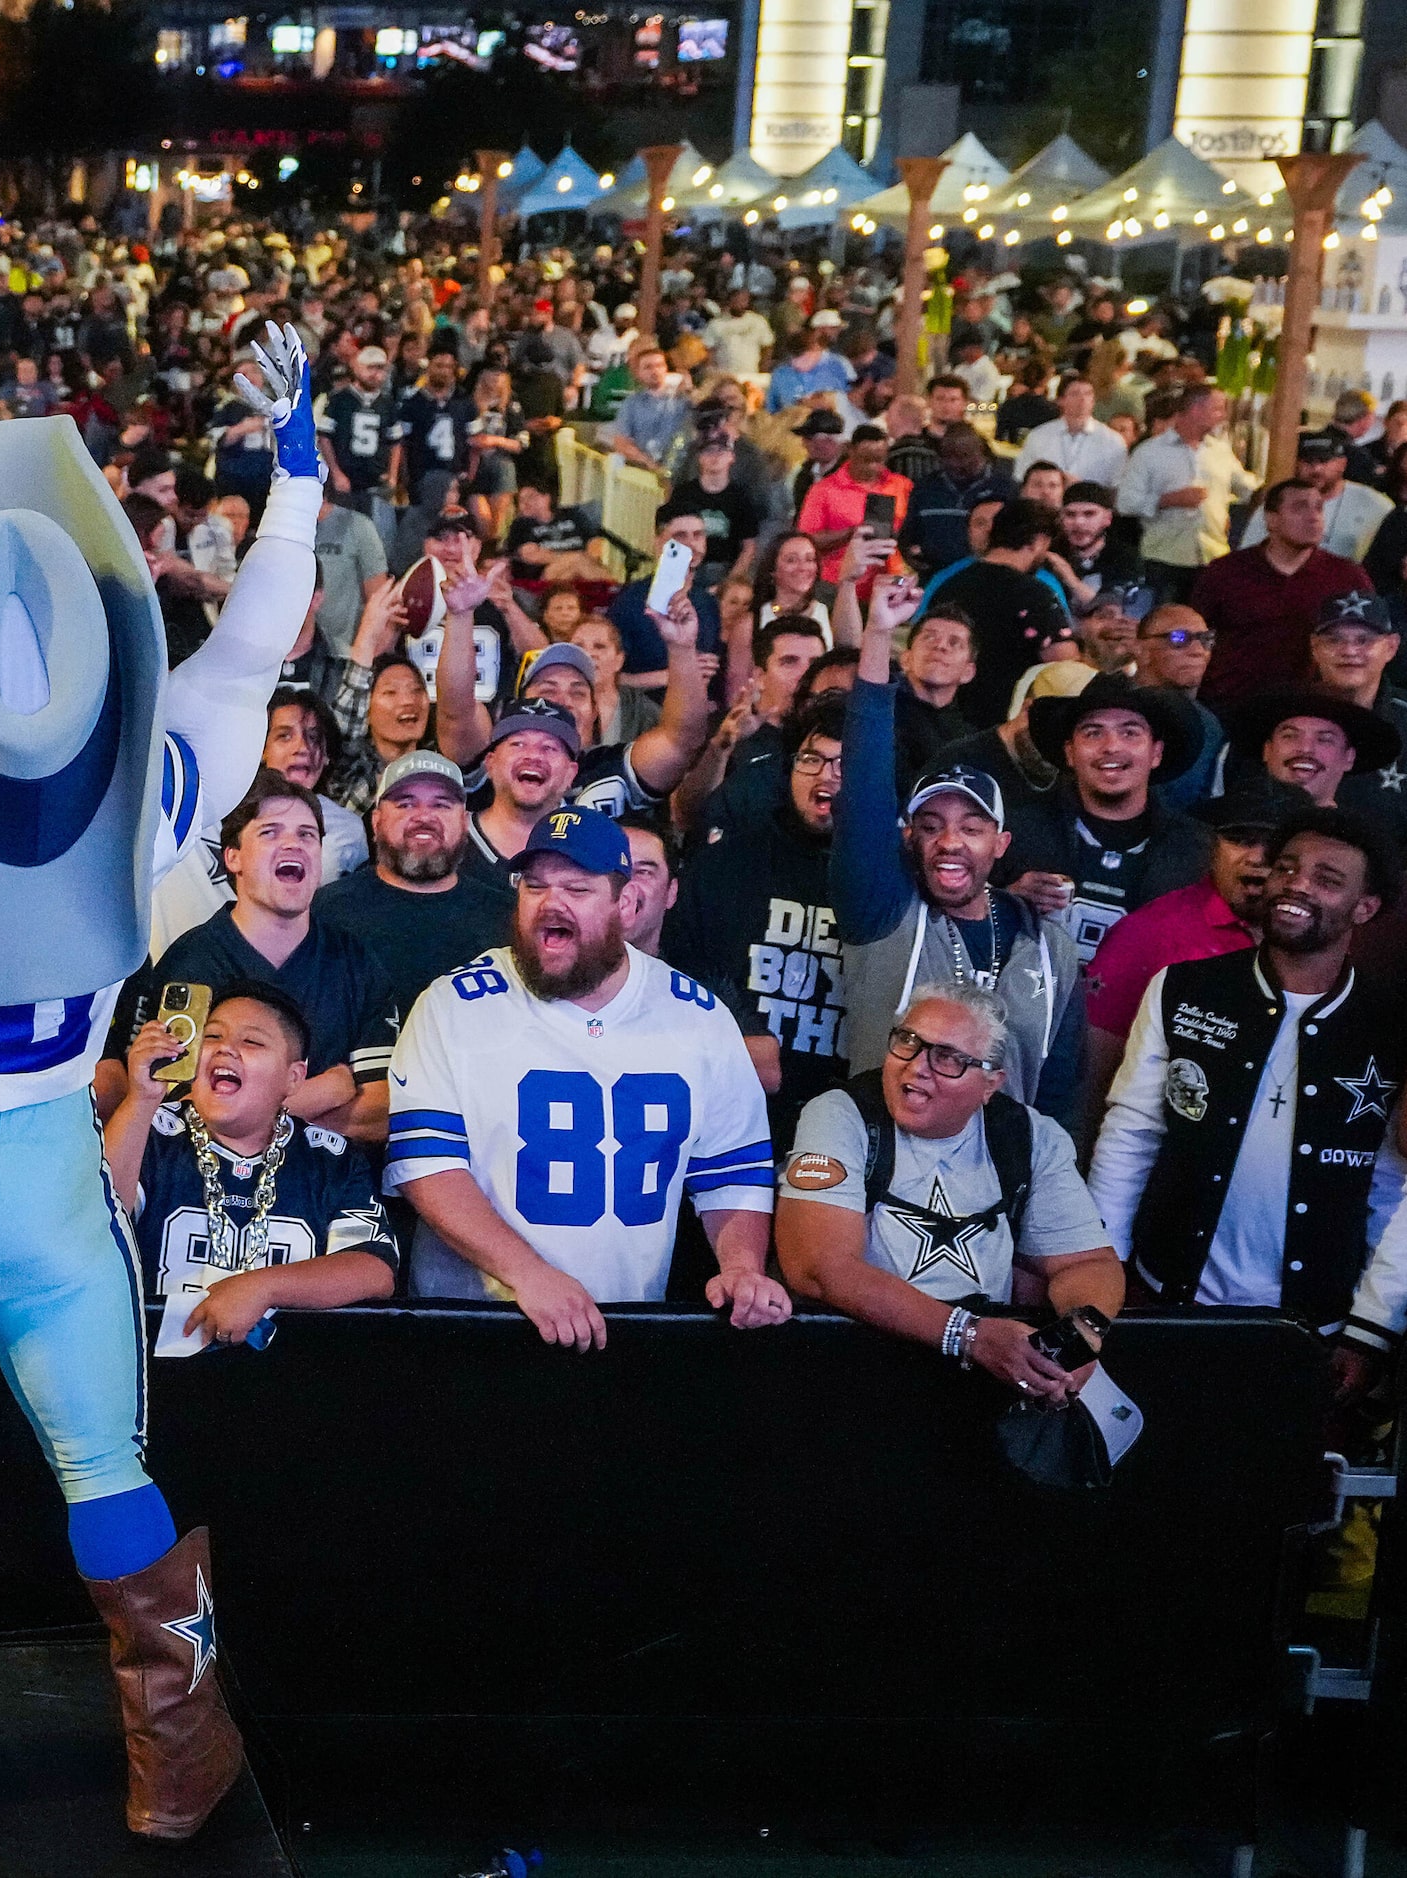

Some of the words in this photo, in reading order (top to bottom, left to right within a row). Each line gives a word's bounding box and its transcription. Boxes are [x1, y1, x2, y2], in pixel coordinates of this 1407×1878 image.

[351, 411, 381, 457] 5
[427, 415, 455, 460] 4
[549, 812, 581, 839] T
[1216, 1027, 1237, 1040] 1960
[516, 1070, 691, 1226] 88
